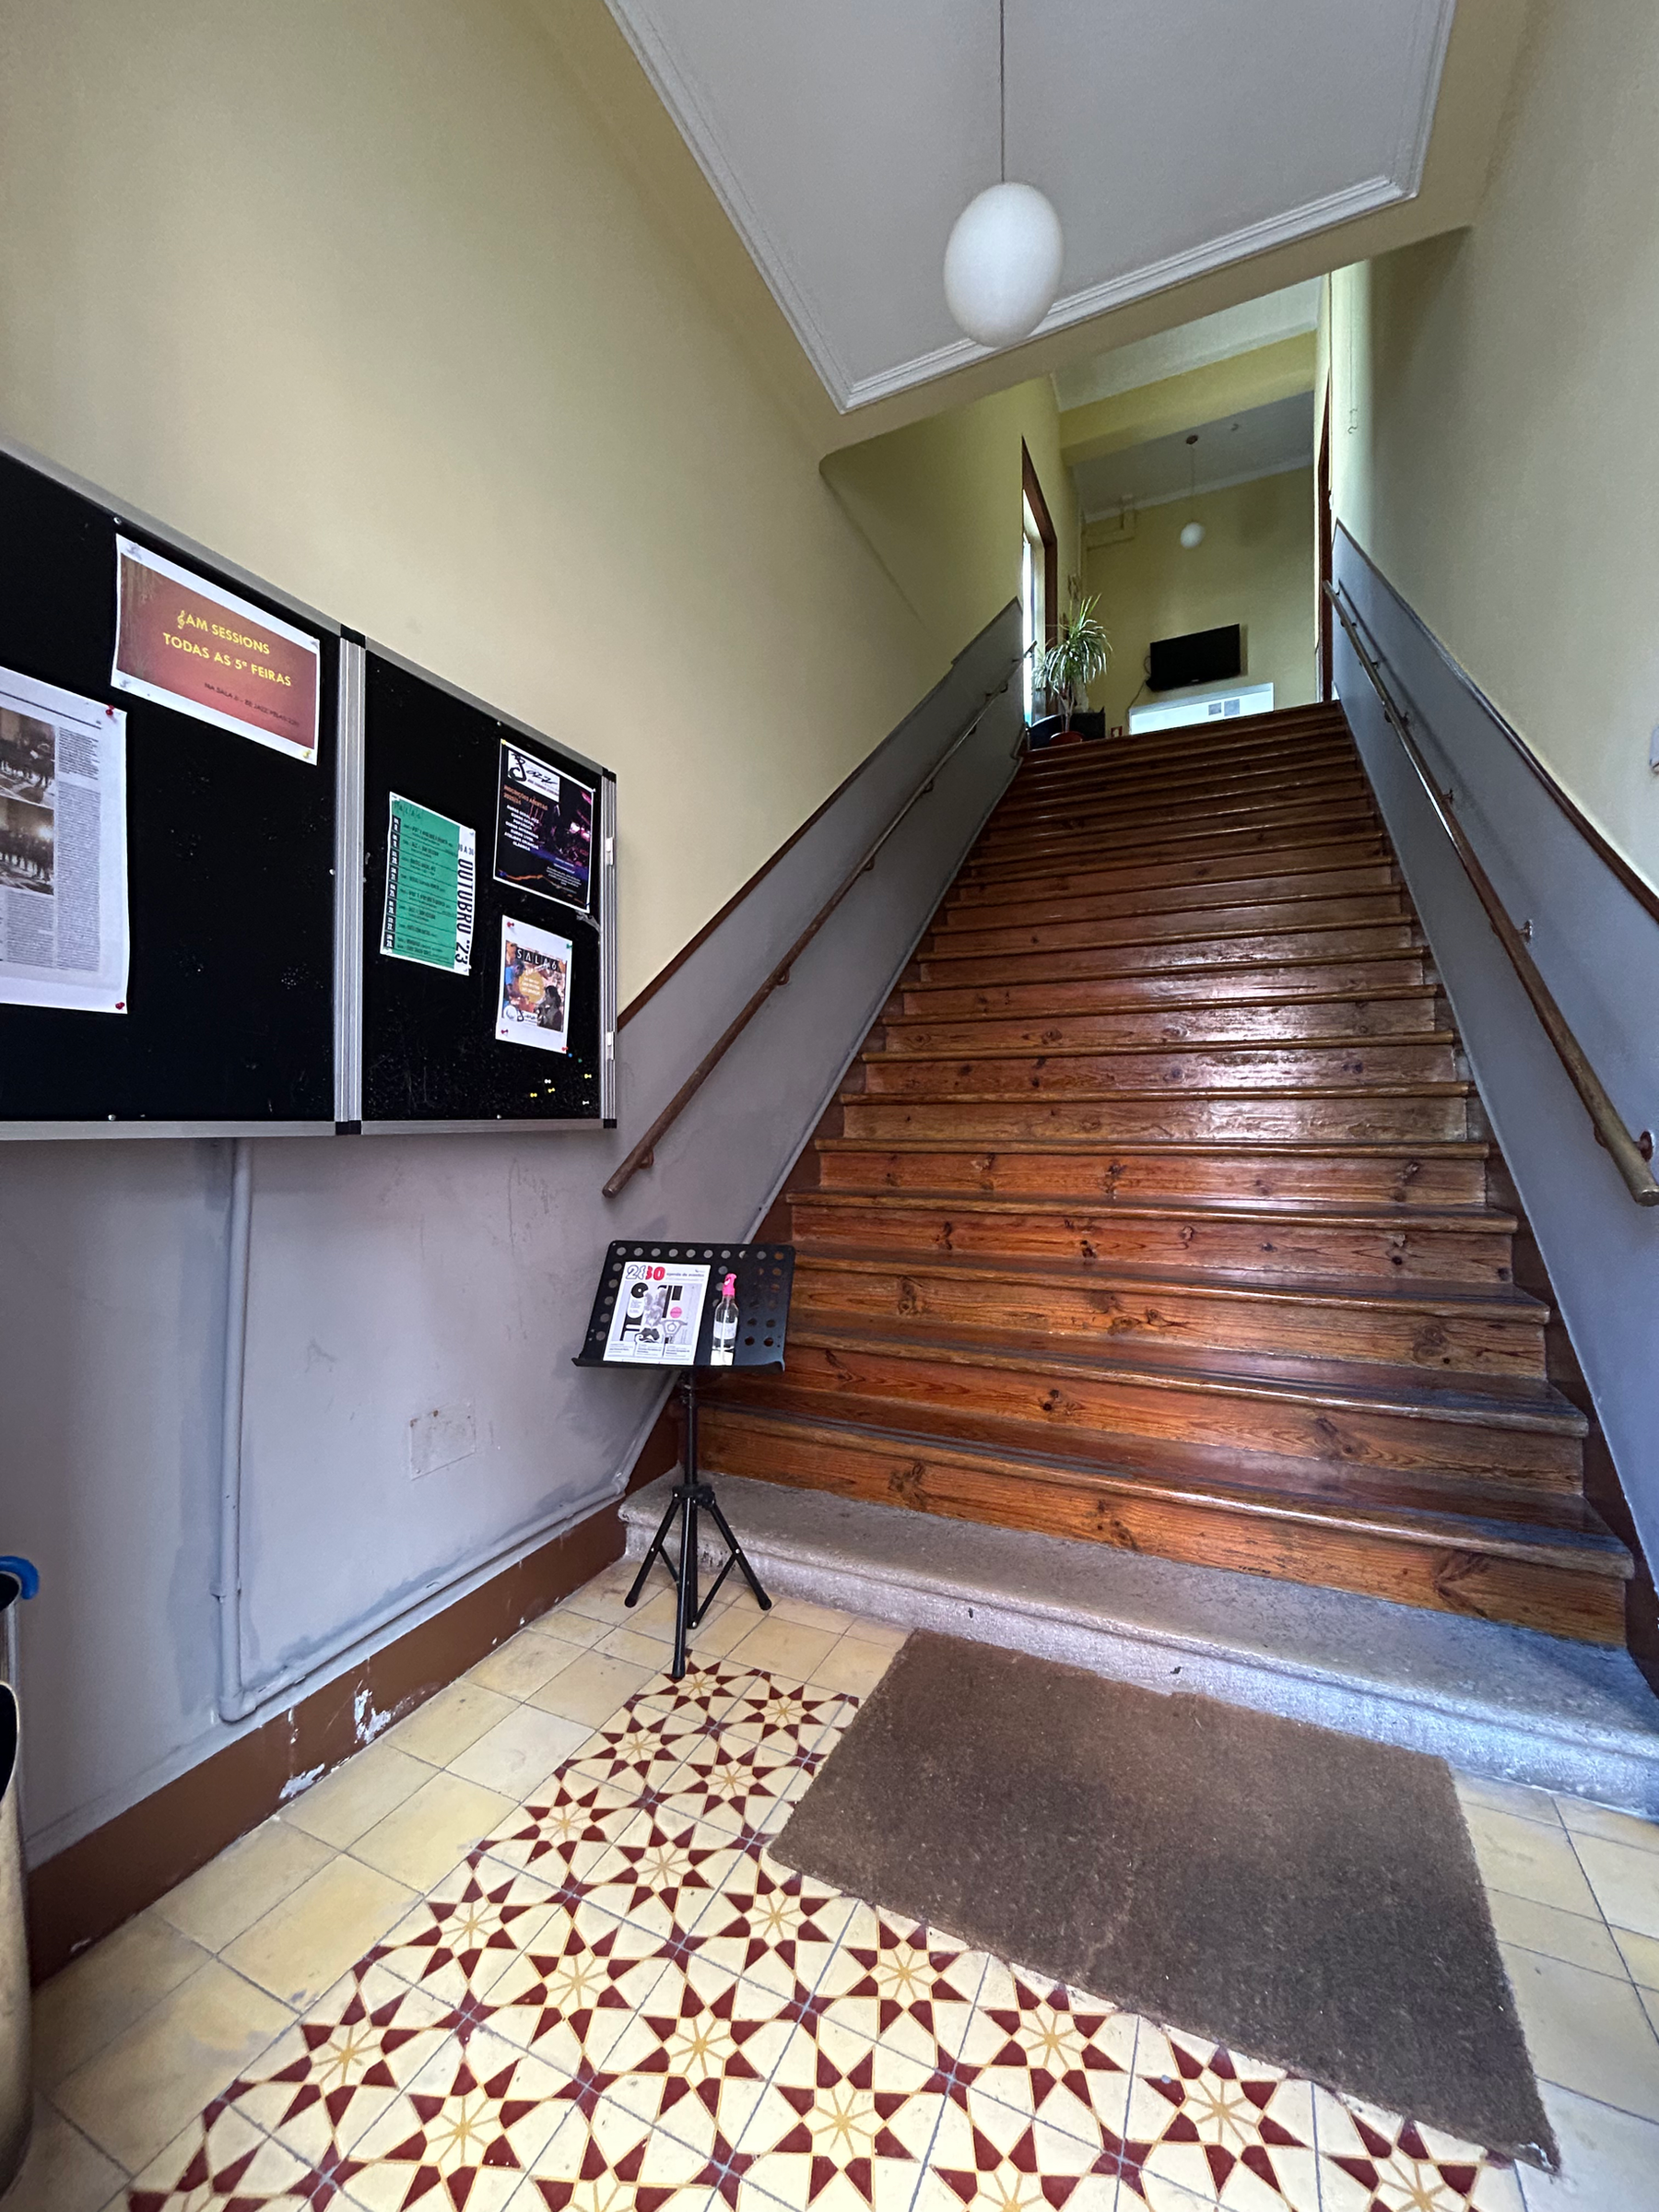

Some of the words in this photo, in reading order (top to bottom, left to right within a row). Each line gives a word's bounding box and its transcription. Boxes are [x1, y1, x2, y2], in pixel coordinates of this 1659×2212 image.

[163, 632, 210, 659] TODAS
[214, 652, 230, 666] AS
[251, 664, 291, 687] FEIRAS
[211, 624, 270, 654] SESSIONS
[457, 858, 473, 935] OUTUBRO
